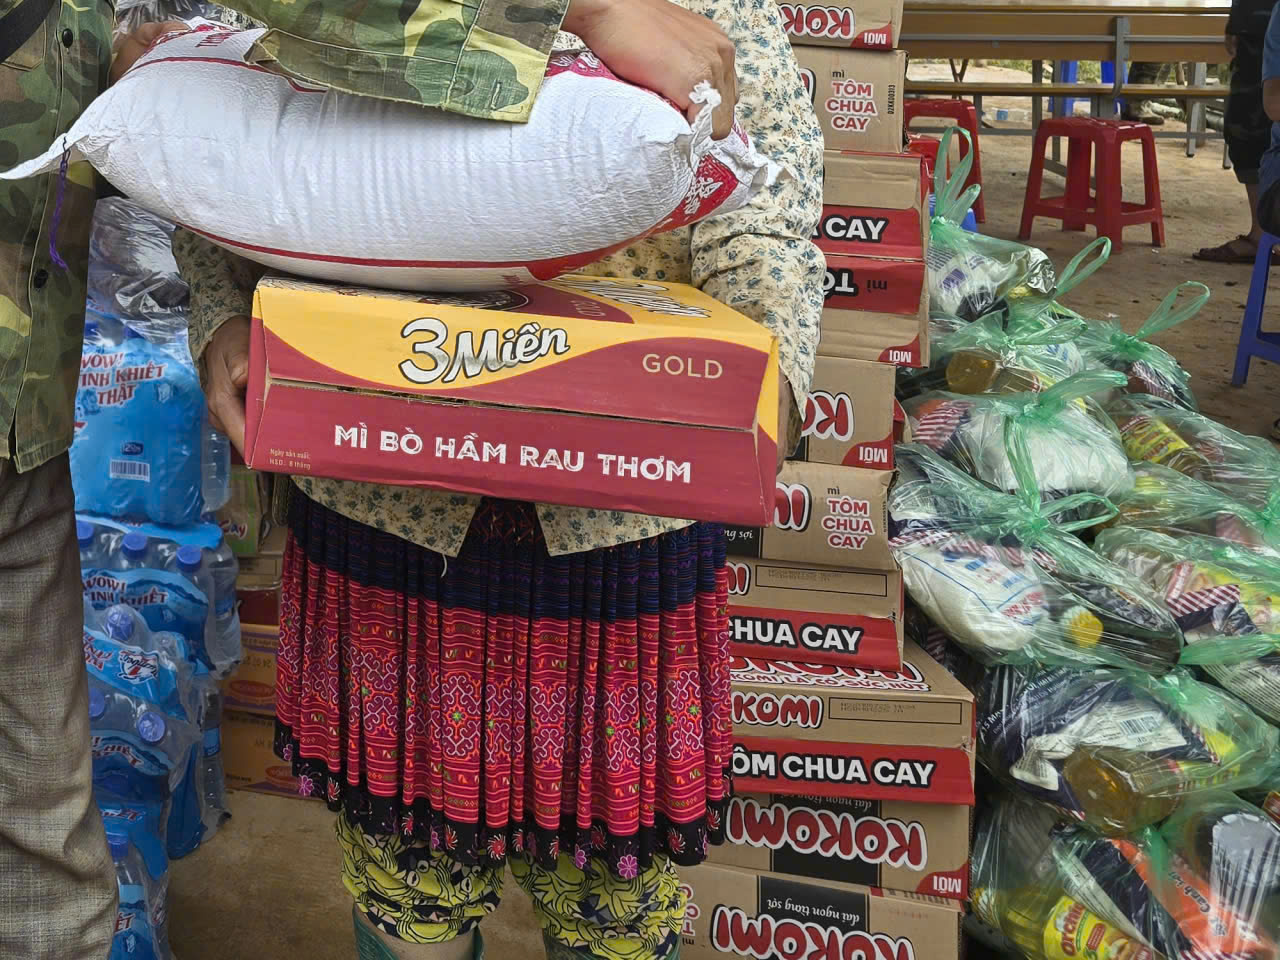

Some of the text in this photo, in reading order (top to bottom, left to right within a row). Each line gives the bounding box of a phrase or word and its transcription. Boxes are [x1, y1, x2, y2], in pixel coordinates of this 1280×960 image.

[832, 70, 844, 78] mì
[832, 80, 871, 97] TÔM
[827, 99, 876, 115] CHUA
[833, 117, 868, 130] CAY
[825, 218, 885, 240] CAY
[116, 361, 165, 383] KHIẾT
[642, 353, 723, 380] GOLD
[98, 384, 136, 406] THẬT
[335, 421, 691, 483] MÌ BÒ HẦM RAU THƠM
[827, 487, 840, 495] mì
[828, 497, 868, 515] TÔM
[823, 517, 873, 534] CHUA
[829, 535, 866, 549] CAY
[802, 626, 861, 651] CAY
[733, 747, 934, 785] ÔM CHUA CAY
[729, 802, 924, 867] KOKOMI
[812, 905, 840, 921] ngon
[841, 912, 860, 926] dai
[717, 909, 915, 960] KOKOMI
